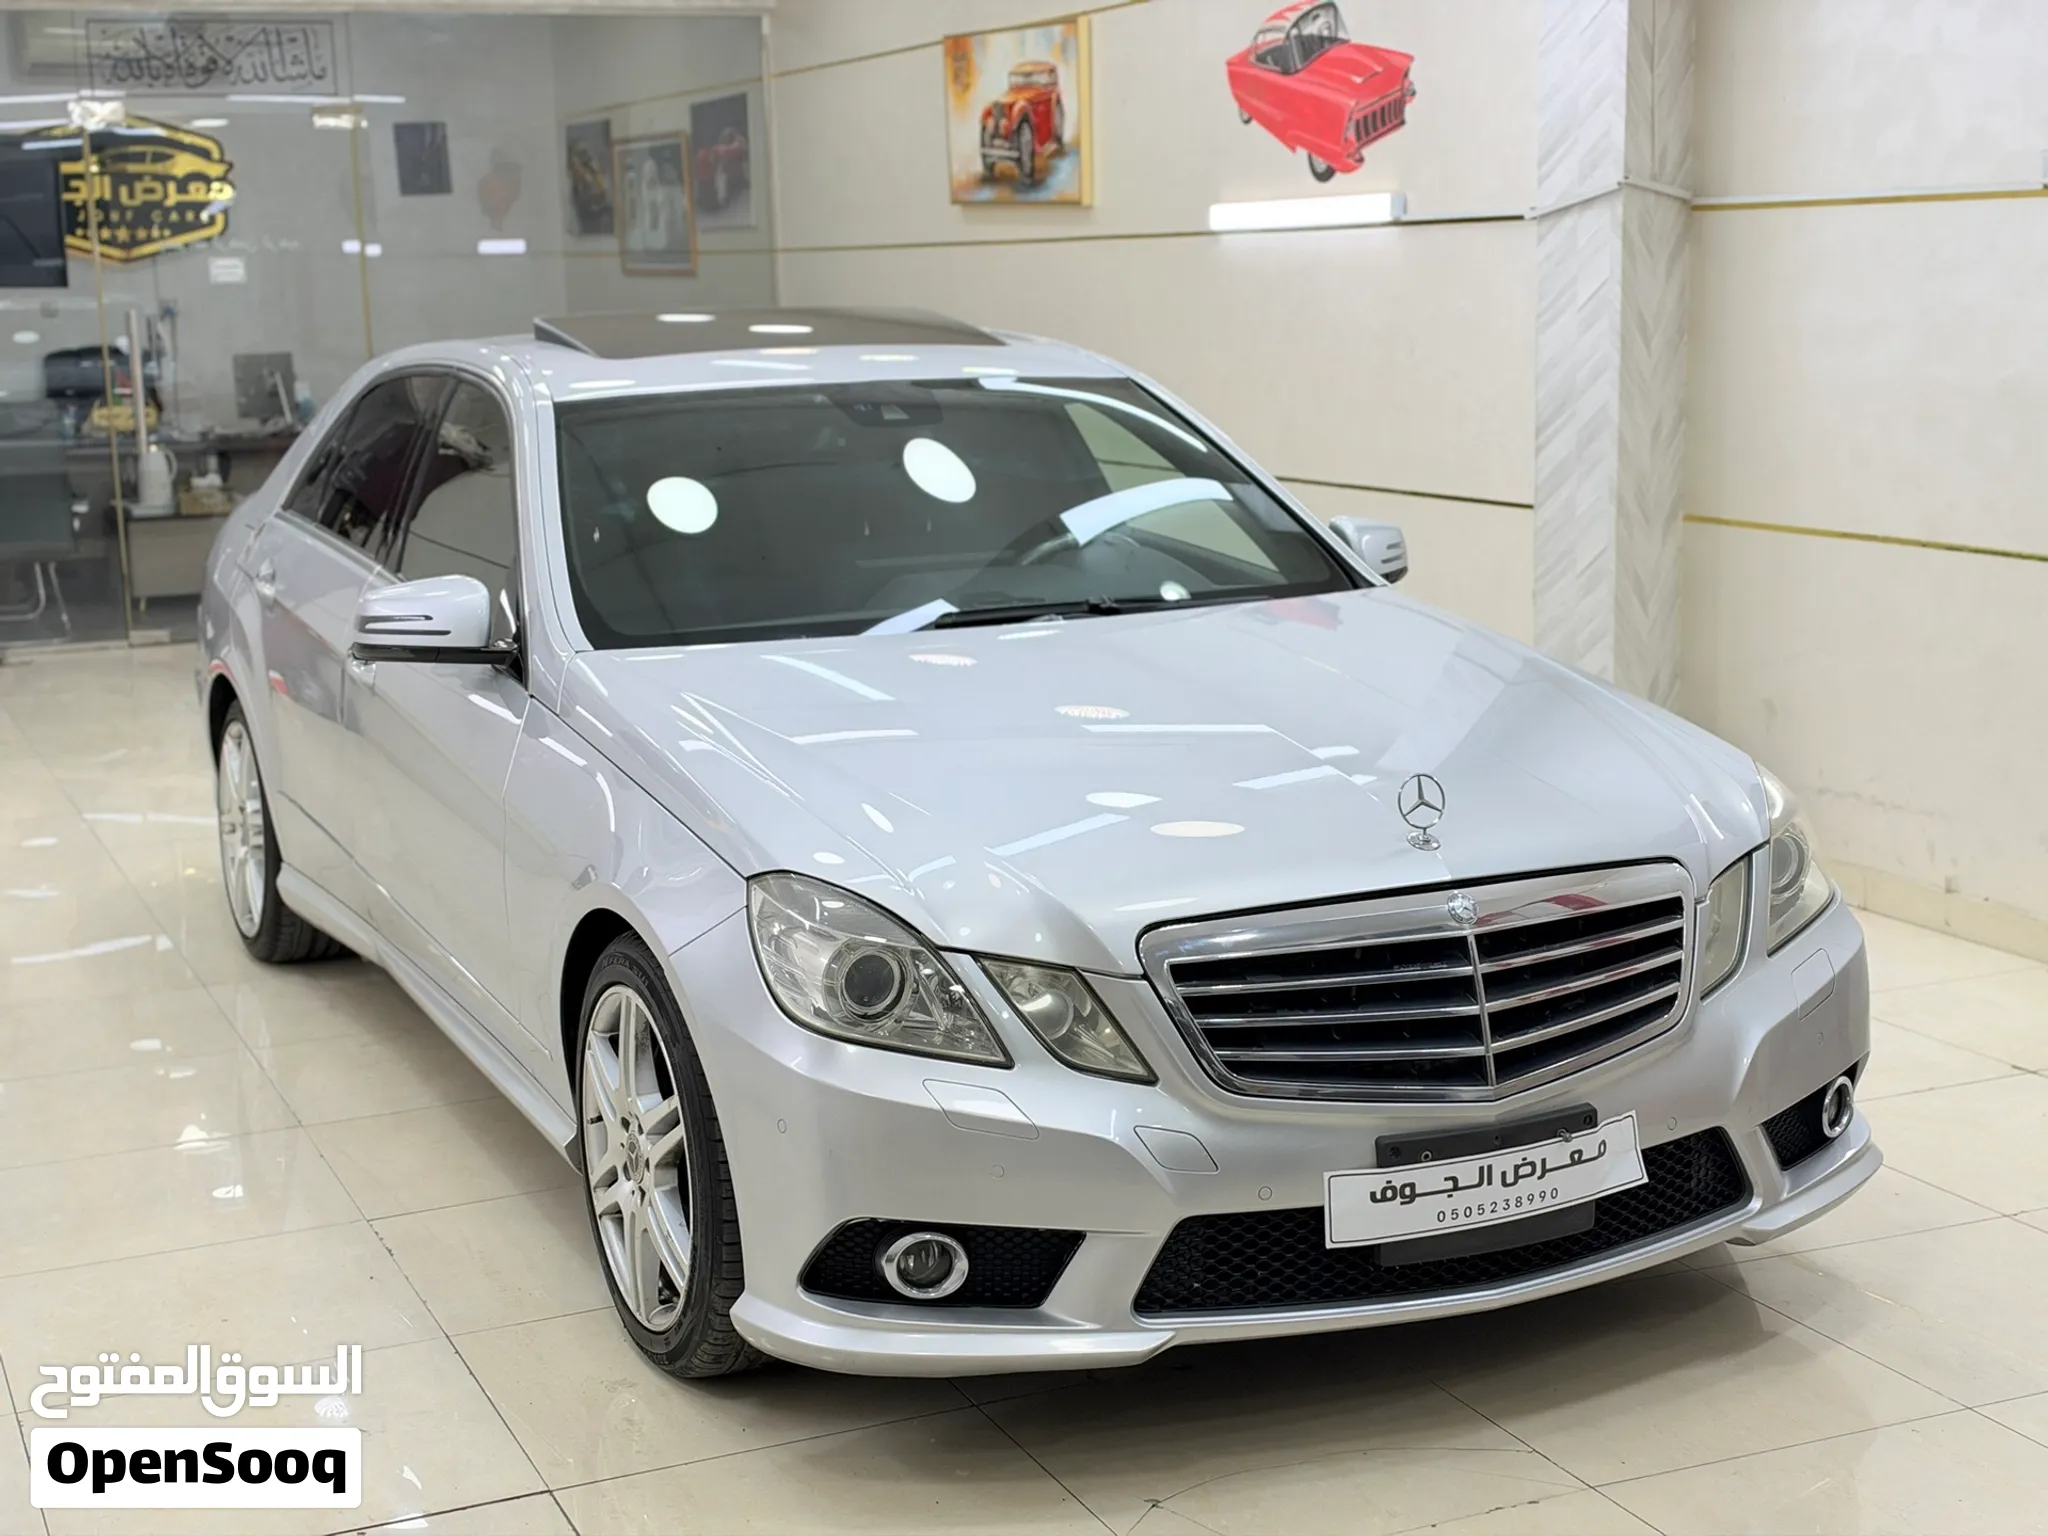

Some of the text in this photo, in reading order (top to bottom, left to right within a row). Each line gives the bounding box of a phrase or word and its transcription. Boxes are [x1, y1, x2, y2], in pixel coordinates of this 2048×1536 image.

[119, 174, 234, 207] معرض
[1369, 1138, 1607, 1206] معرض الجوف
[1436, 1187, 1559, 1224] 0505238990
